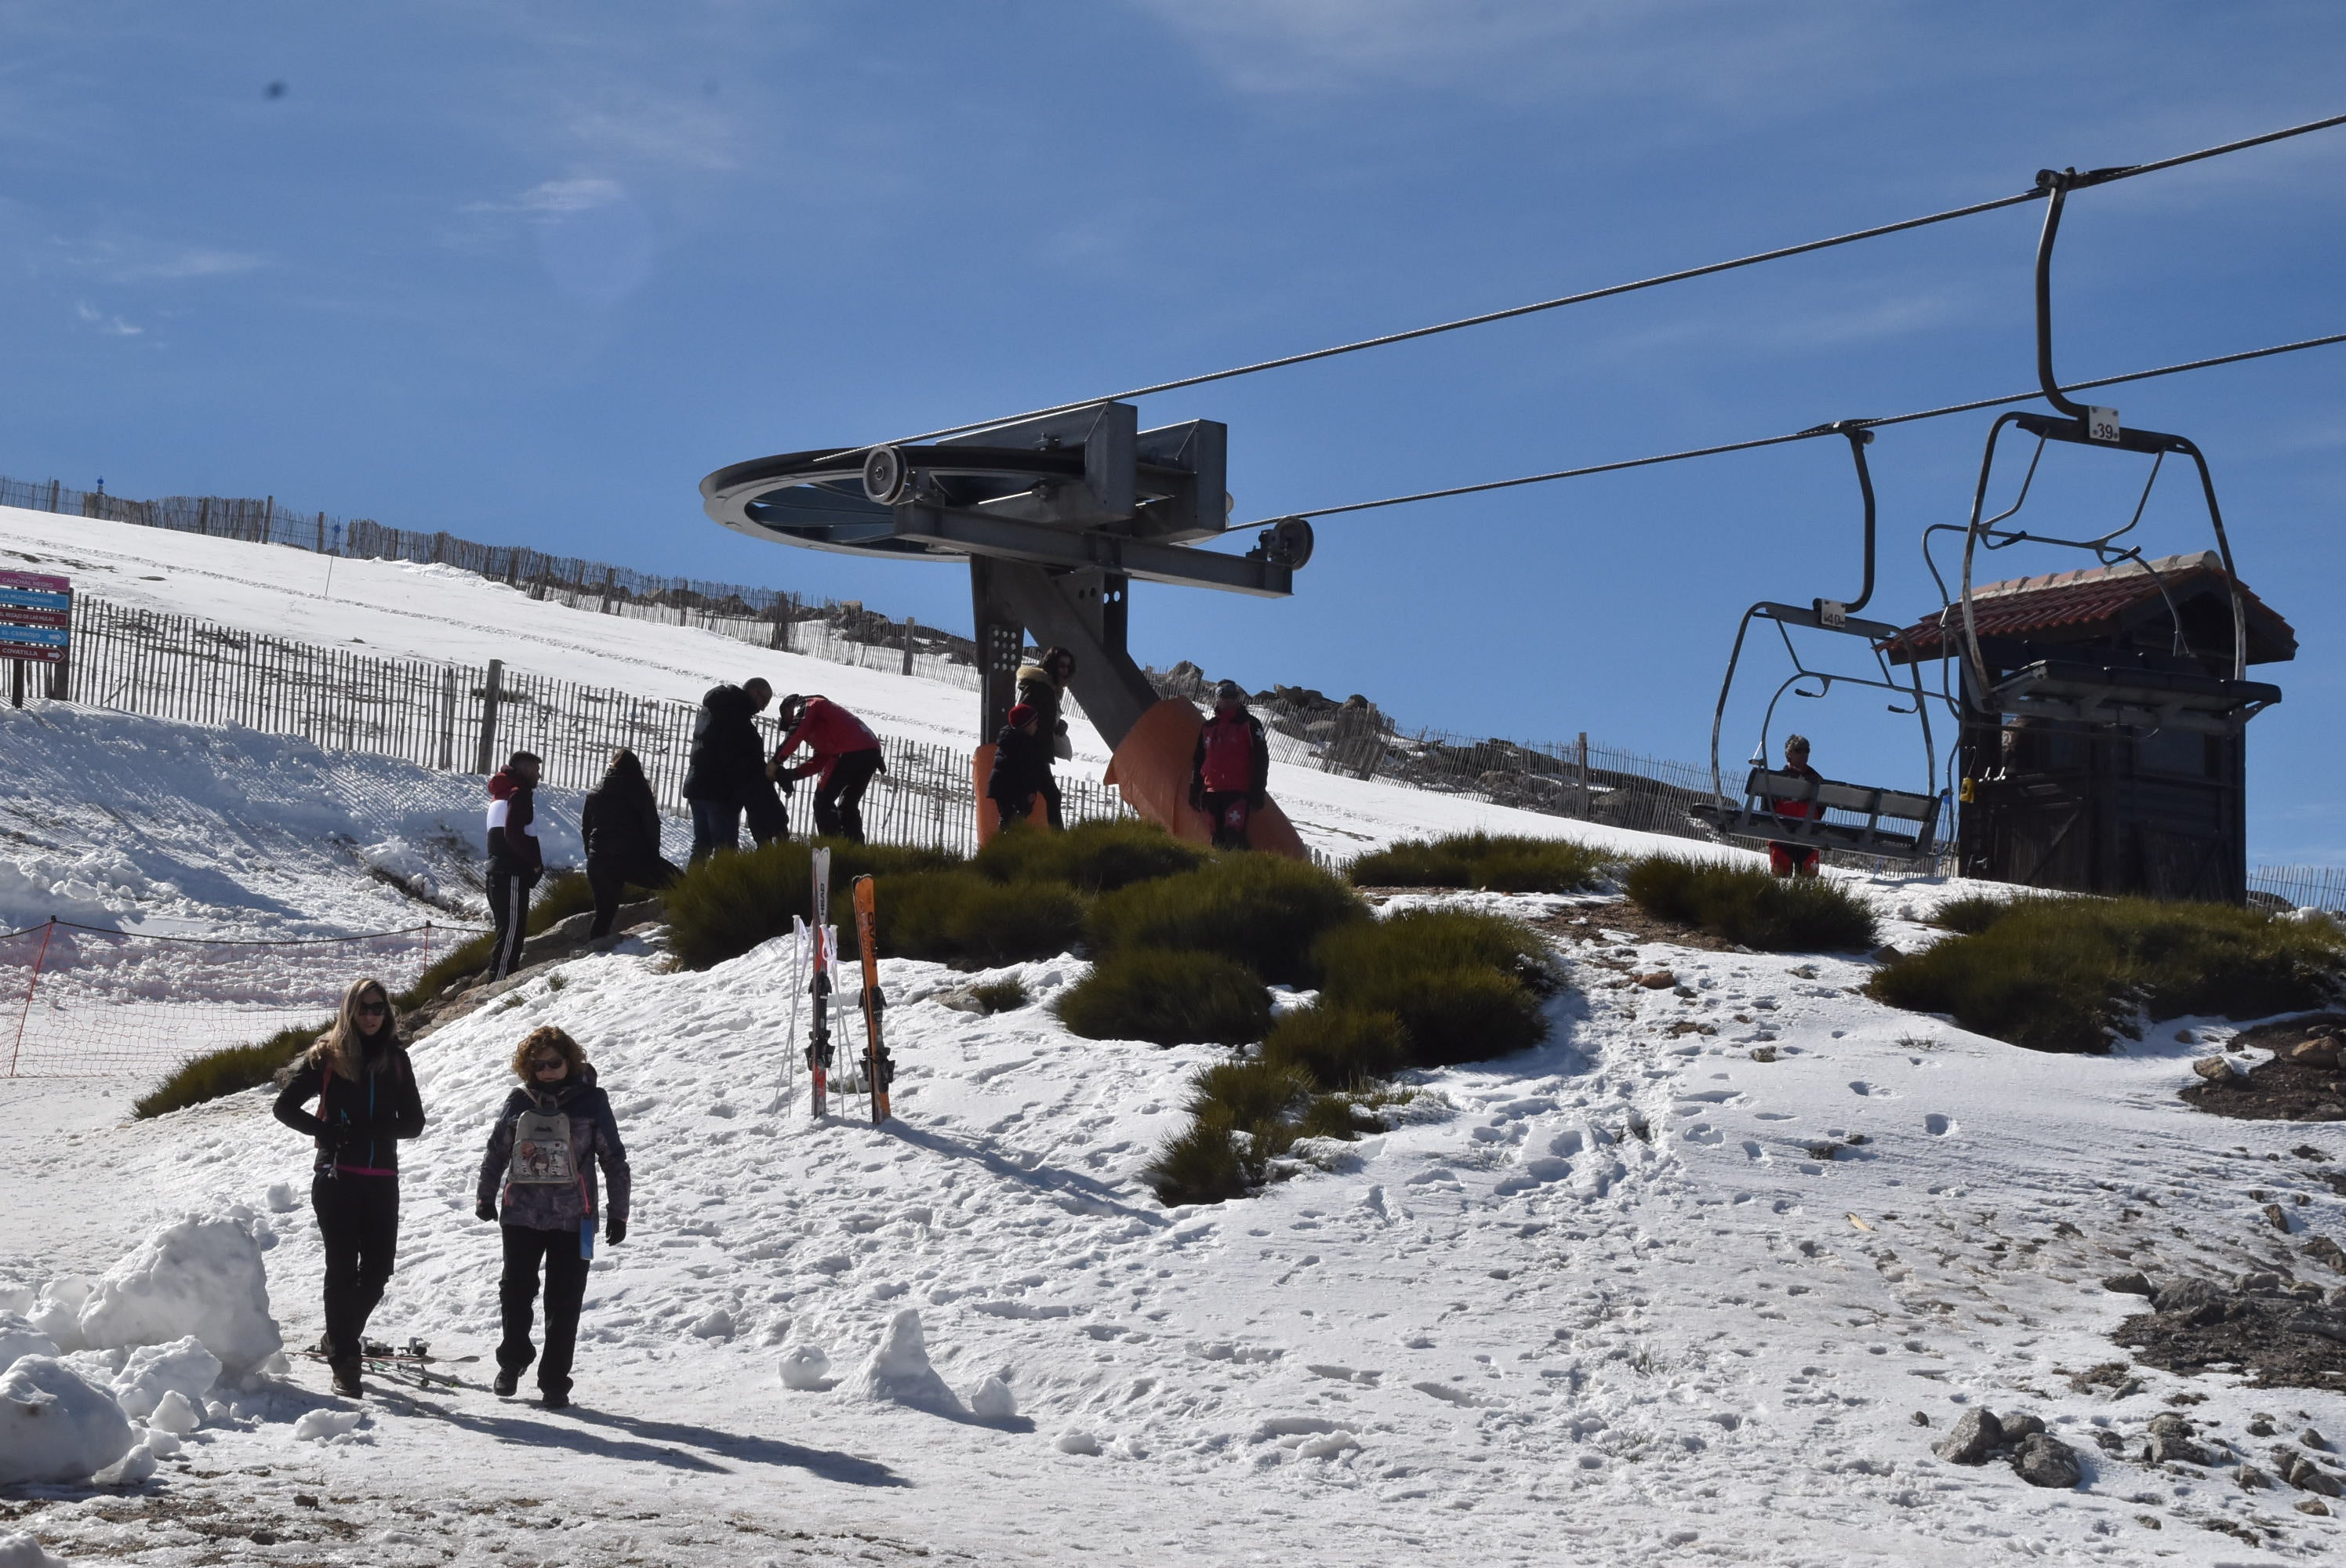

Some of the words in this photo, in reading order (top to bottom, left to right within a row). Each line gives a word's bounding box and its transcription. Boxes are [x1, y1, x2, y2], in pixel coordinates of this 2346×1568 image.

[2097, 423, 2113, 439] 39
[2, 577, 31, 586] CANCHAL
[2, 648, 38, 656] COVATILLA
[868, 912, 877, 967] HEAD
